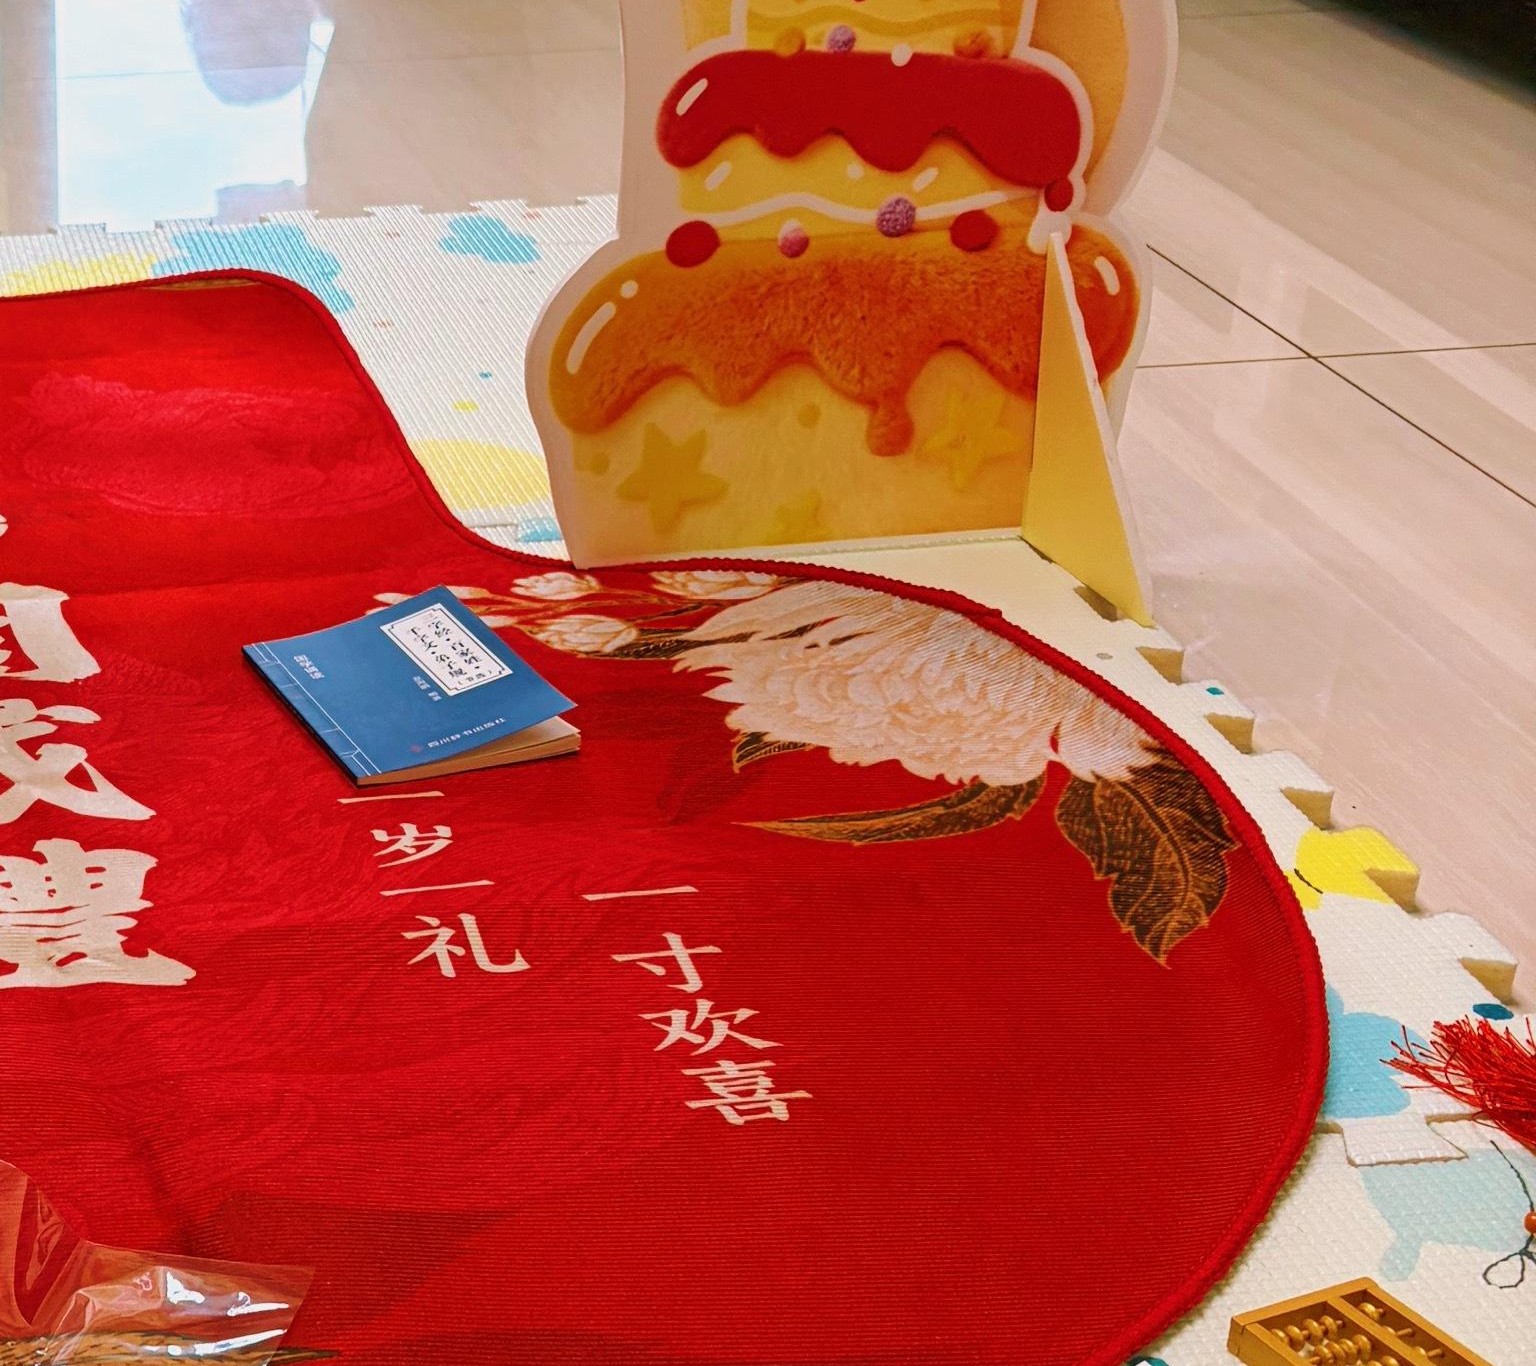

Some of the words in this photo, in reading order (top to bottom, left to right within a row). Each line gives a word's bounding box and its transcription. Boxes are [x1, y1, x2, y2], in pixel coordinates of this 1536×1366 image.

[336, 787, 530, 979] 一岁一礼
[581, 884, 813, 1127] 一寸欢喜
